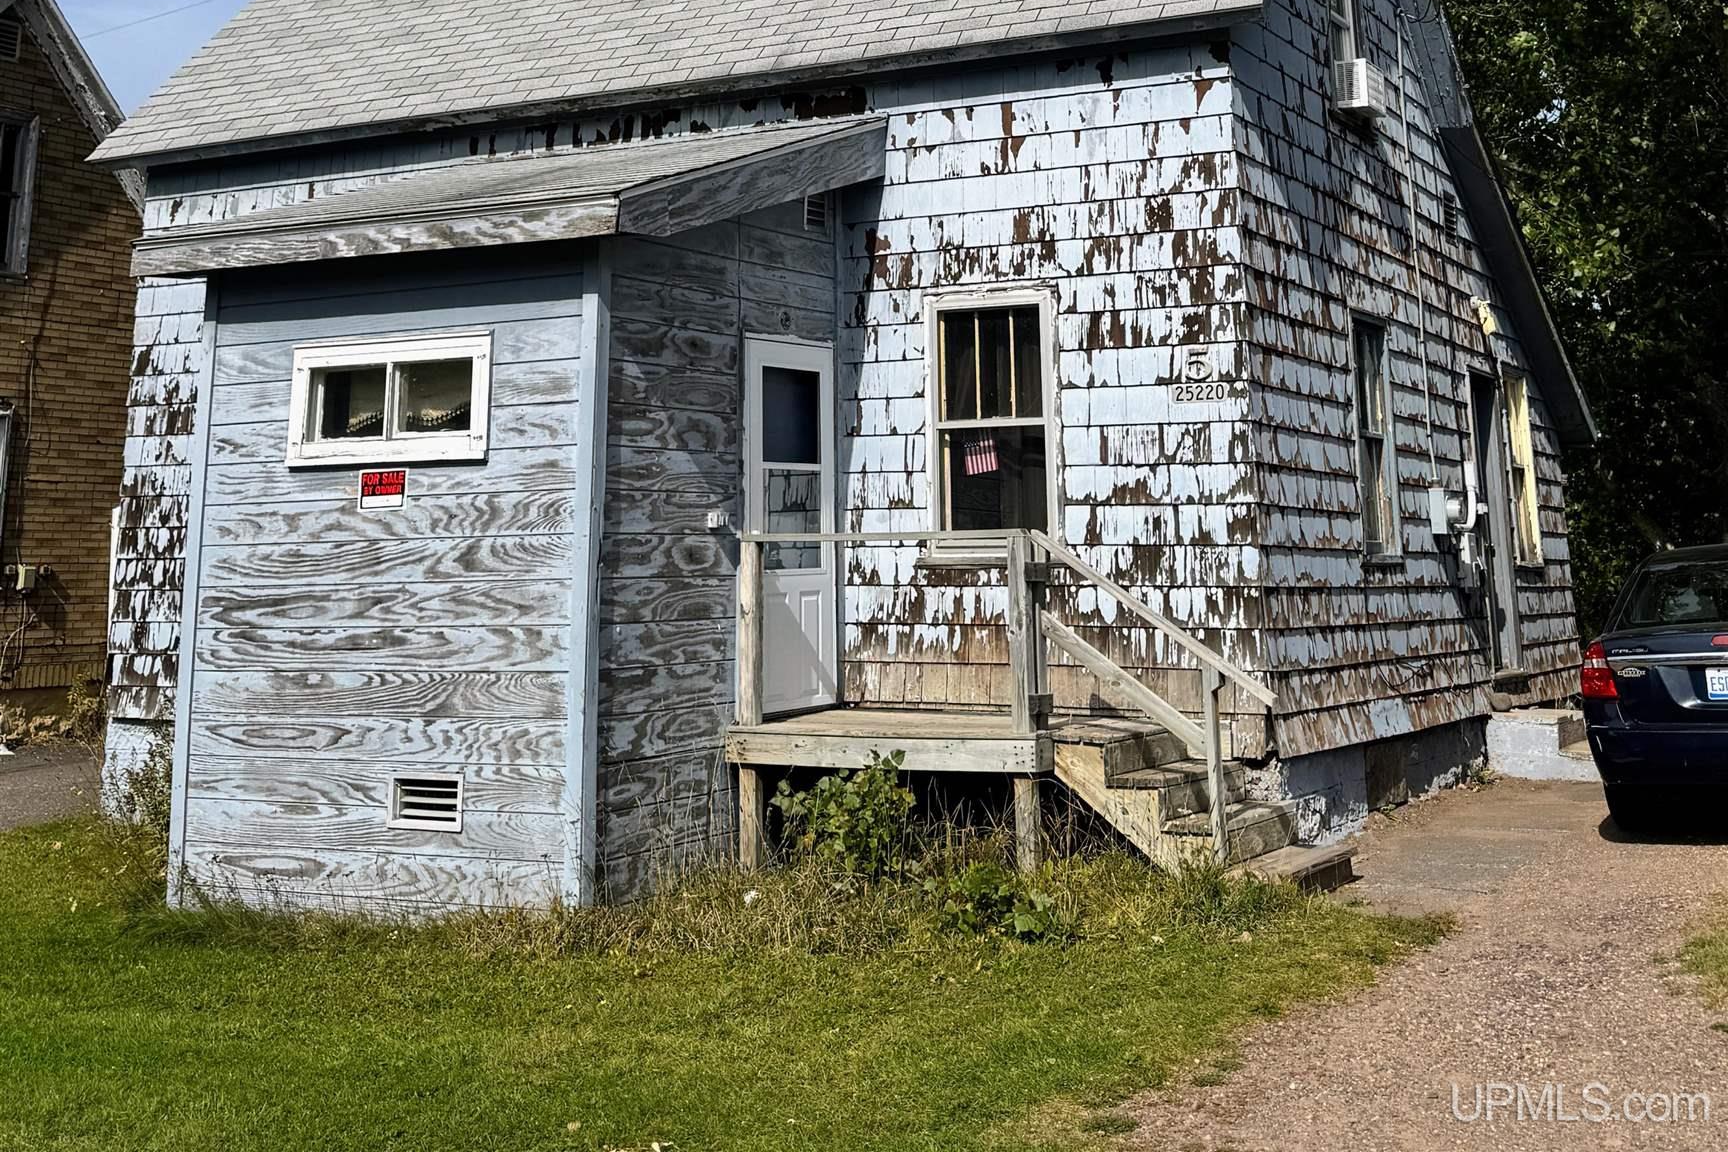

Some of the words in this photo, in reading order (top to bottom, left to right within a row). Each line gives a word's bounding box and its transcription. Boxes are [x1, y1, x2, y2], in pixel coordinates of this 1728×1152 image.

[1185, 343, 1213, 383] 5
[1175, 383, 1225, 402] 25220
[362, 473, 380, 486] FOR
[382, 471, 405, 484] SALE
[363, 486, 374, 495] BY
[375, 484, 402, 495] OWNER
